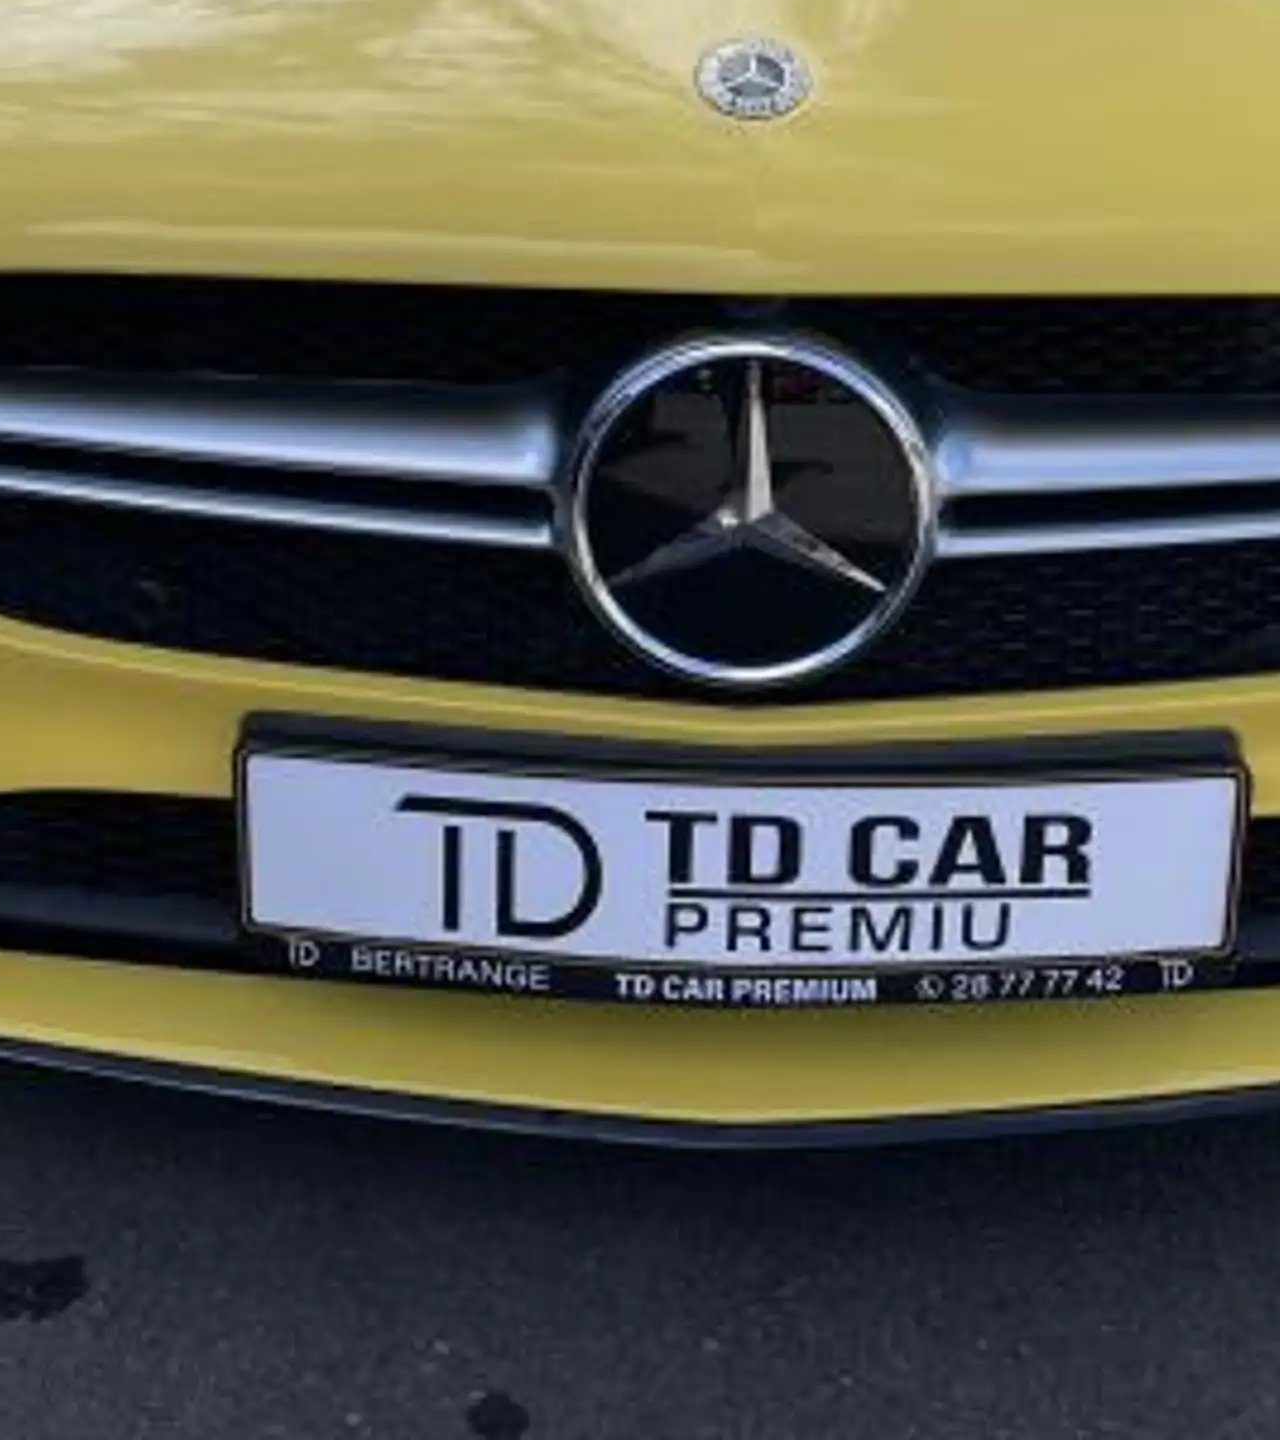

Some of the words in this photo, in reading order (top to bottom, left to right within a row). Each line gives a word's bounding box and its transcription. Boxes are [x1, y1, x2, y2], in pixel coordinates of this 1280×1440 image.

[645, 810, 803, 885] TD
[847, 815, 1092, 887] CAR
[663, 903, 1011, 952] PREMIU
[288, 939, 320, 967] TD
[351, 946, 551, 990] BERTRANGE
[616, 973, 654, 997] TD
[662, 974, 723, 1000] CAR
[731, 978, 877, 1003] PREMIUM
